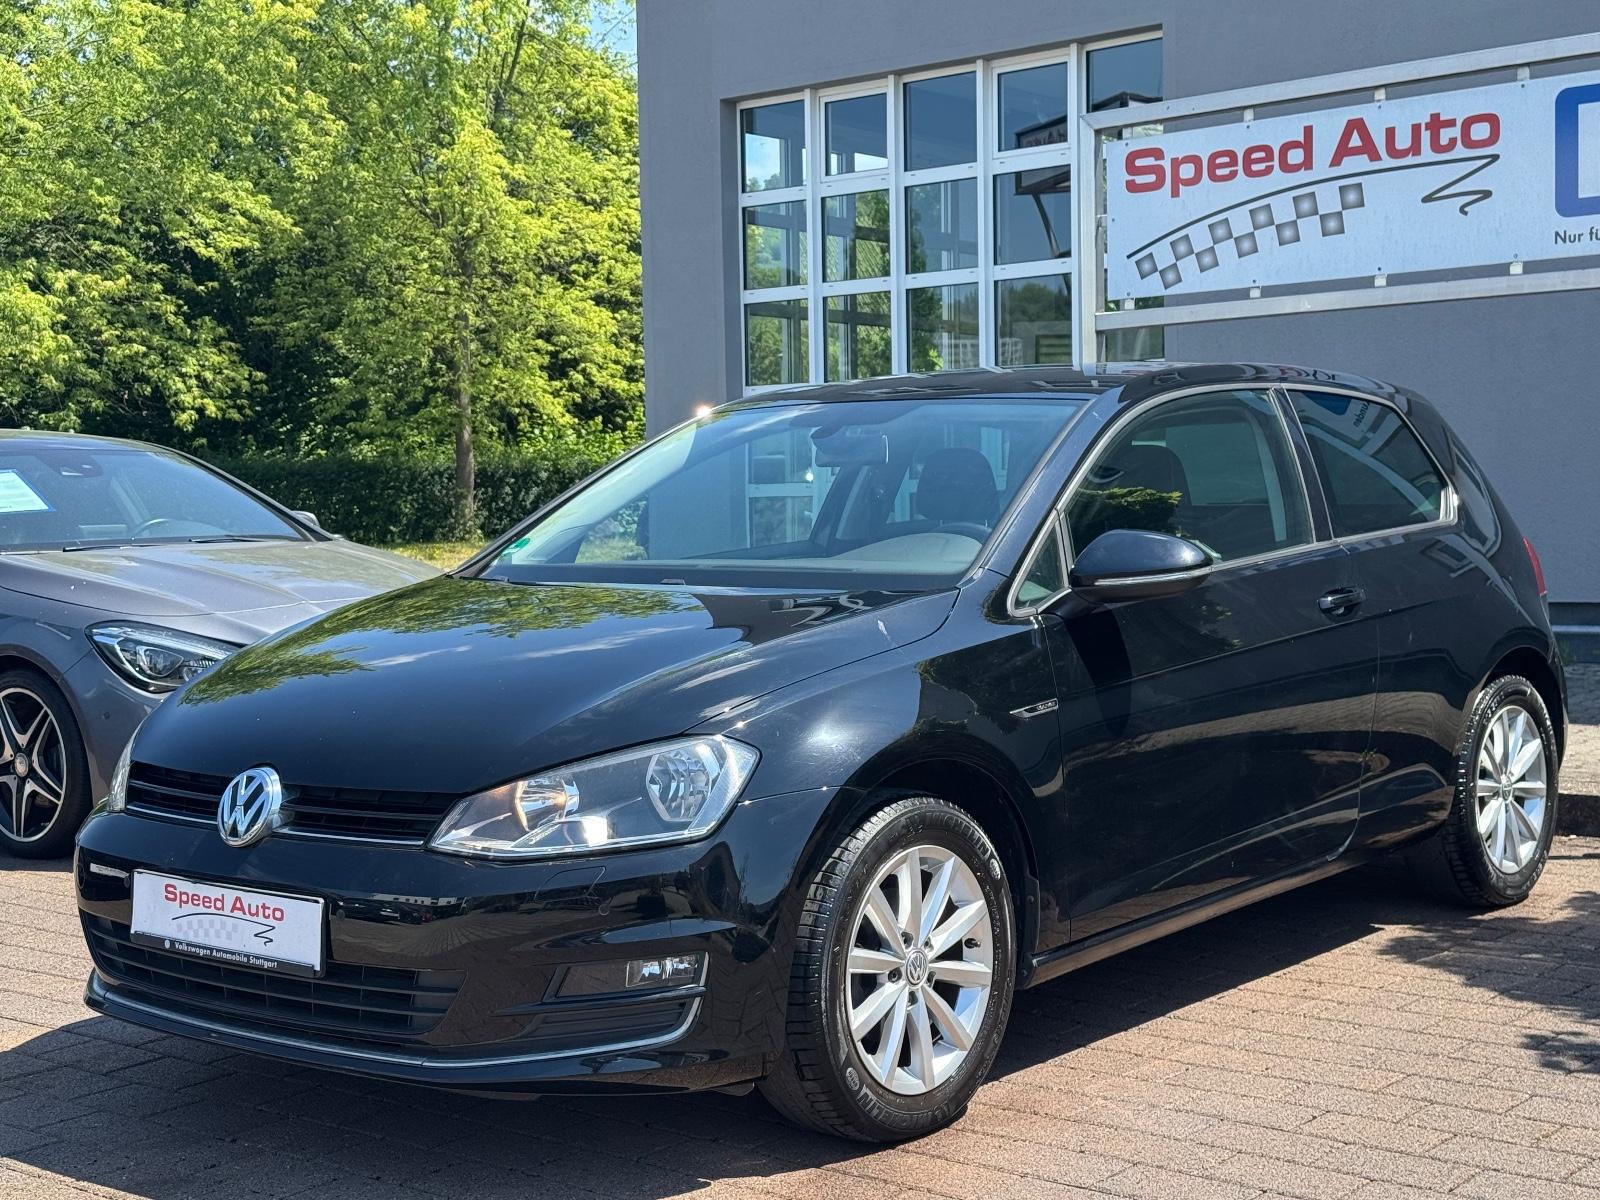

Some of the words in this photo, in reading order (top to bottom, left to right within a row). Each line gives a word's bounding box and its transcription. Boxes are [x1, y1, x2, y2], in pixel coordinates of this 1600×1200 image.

[1124, 124, 1314, 198] Speed
[1328, 112, 1500, 167] Auto
[1554, 229, 1584, 245] Nur
[164, 883, 225, 912] Speed
[230, 896, 285, 922] Auto
[174, 941, 211, 956] Volkswagen
[249, 955, 278, 969] Stuttgart
